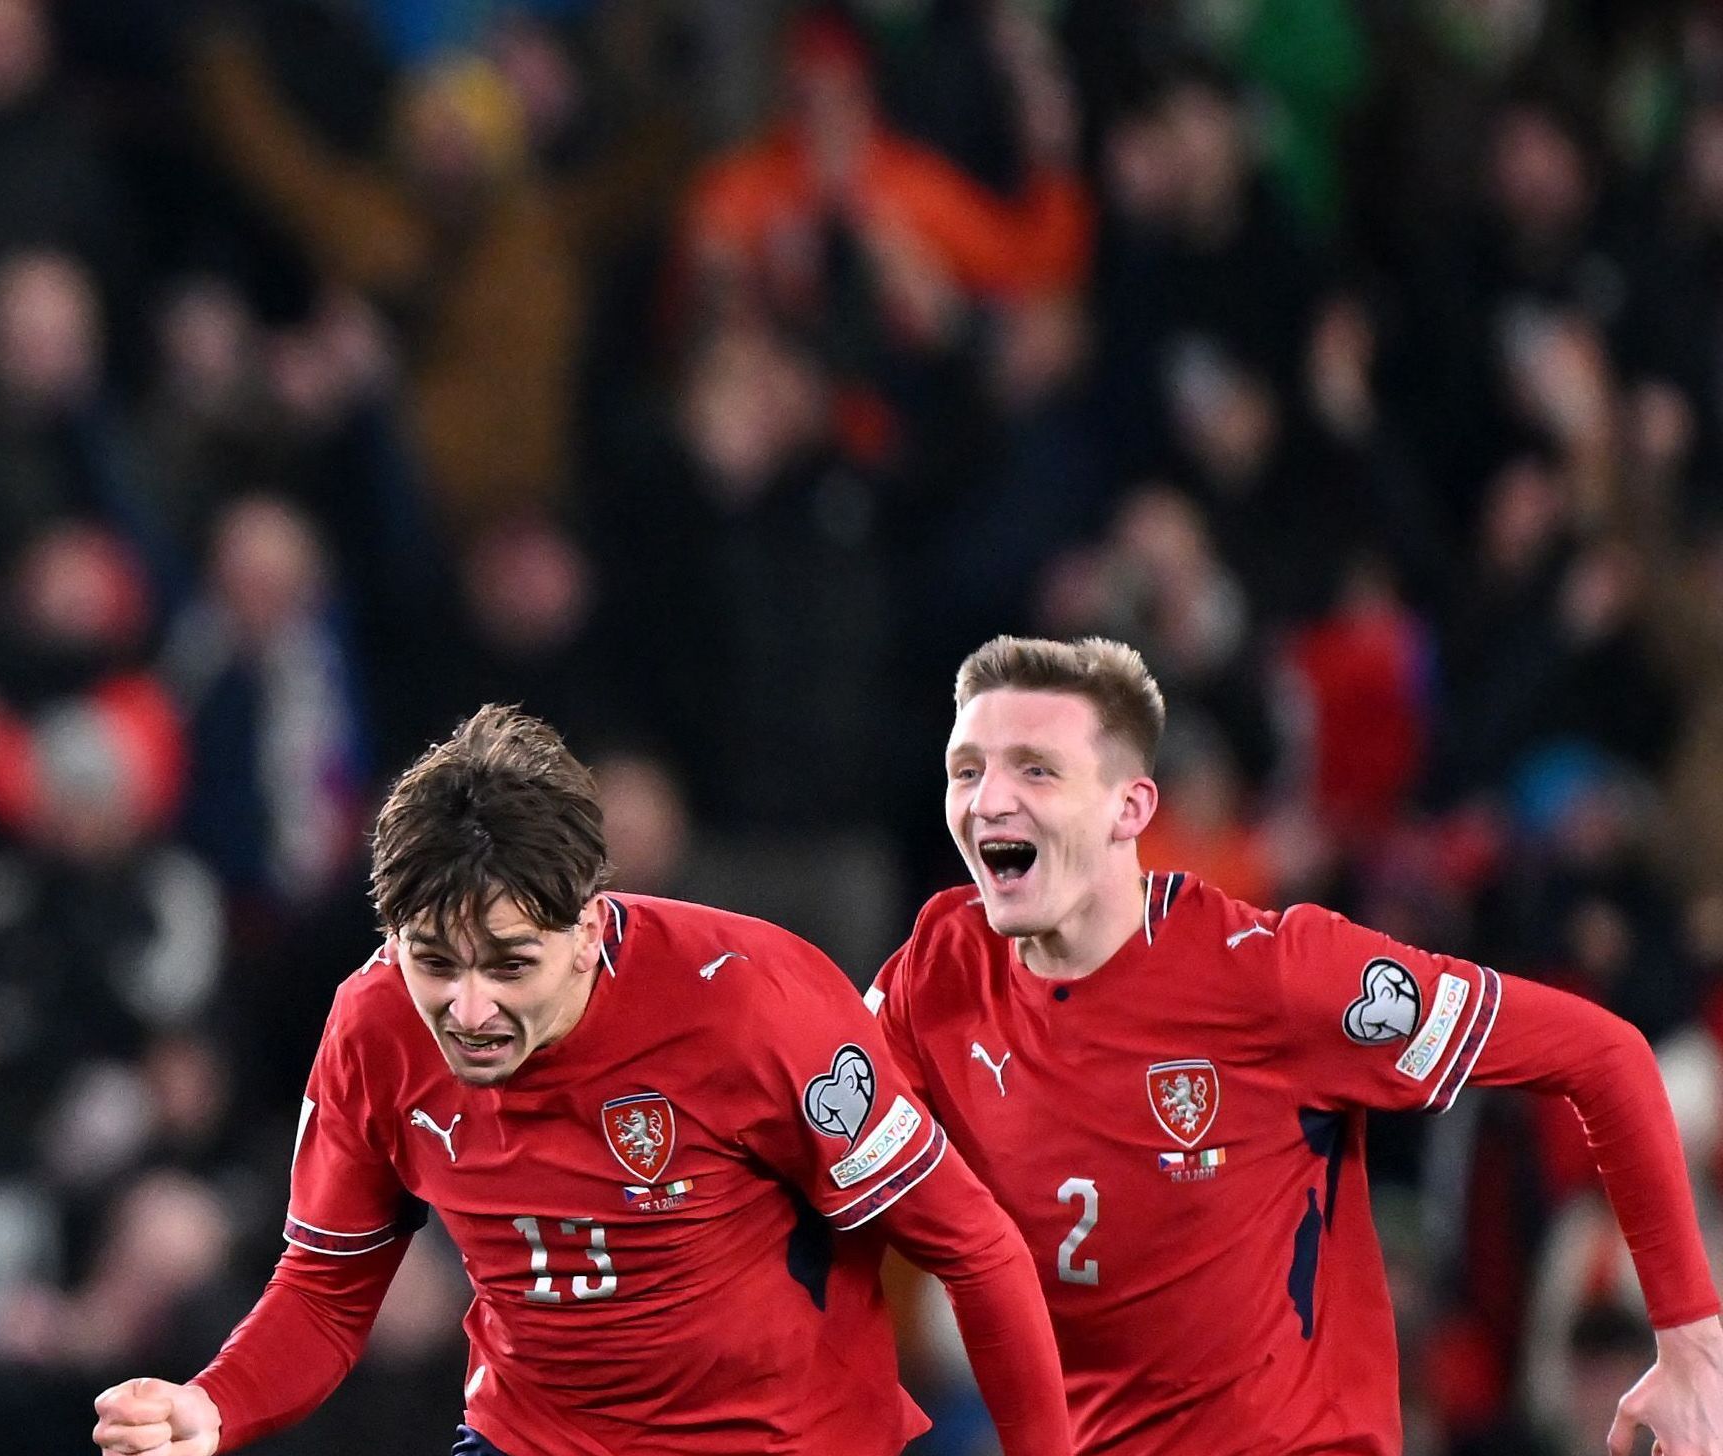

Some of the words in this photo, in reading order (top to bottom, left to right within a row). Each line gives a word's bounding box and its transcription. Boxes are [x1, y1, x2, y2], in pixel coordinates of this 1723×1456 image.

[1407, 979, 1460, 1073] FOUNDATION
[837, 1105, 914, 1181] FOUNDATION
[513, 1216, 617, 1303] 13
[1057, 1177, 1098, 1284] 2
